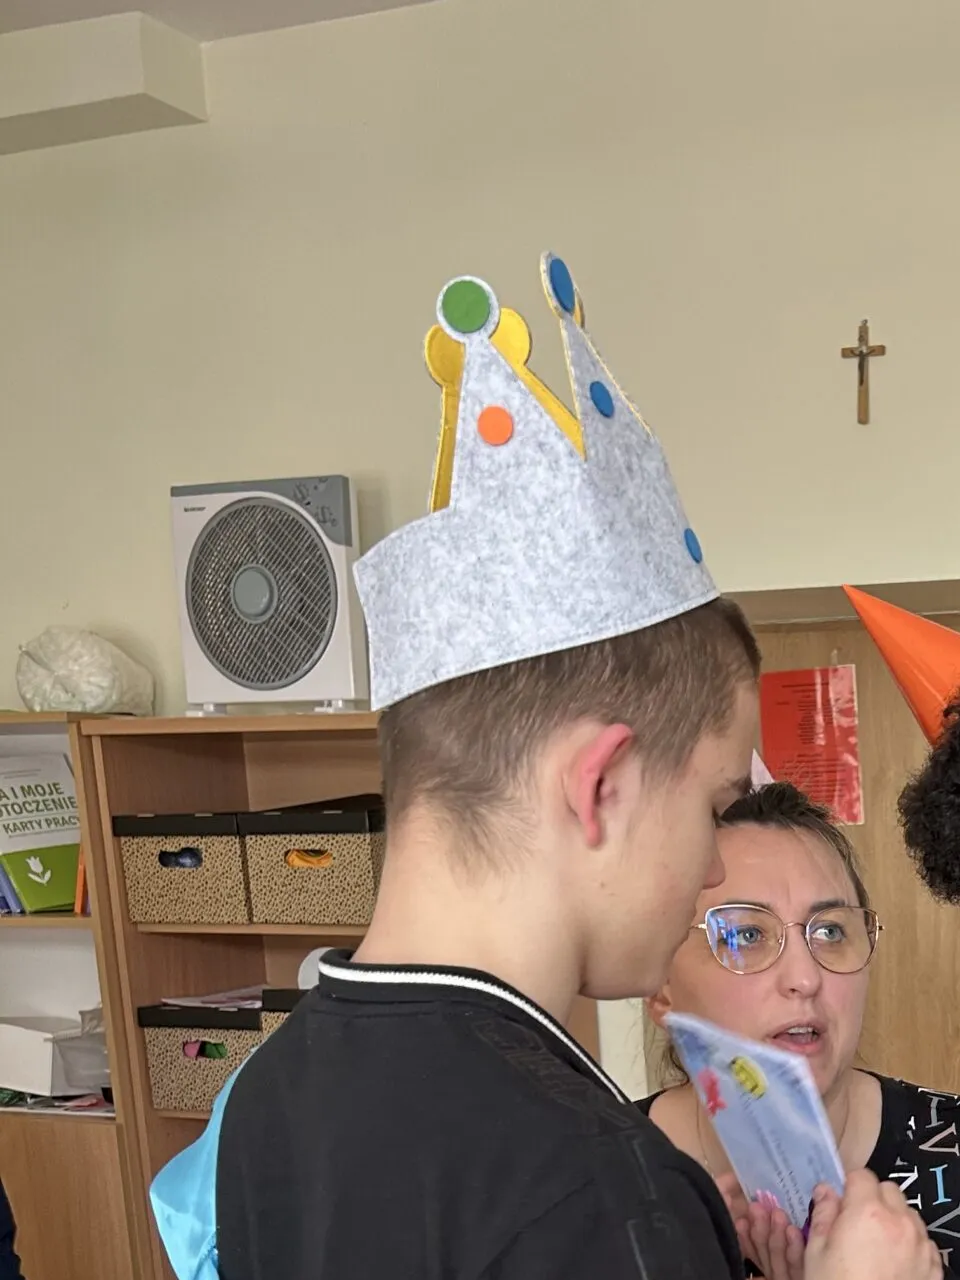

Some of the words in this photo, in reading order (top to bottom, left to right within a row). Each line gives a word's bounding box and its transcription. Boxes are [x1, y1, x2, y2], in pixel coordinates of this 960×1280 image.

[10, 786, 19, 800] I
[20, 782, 64, 798] MOJE
[0, 796, 78, 817] TOCZENIE
[2, 819, 43, 835] KARTY
